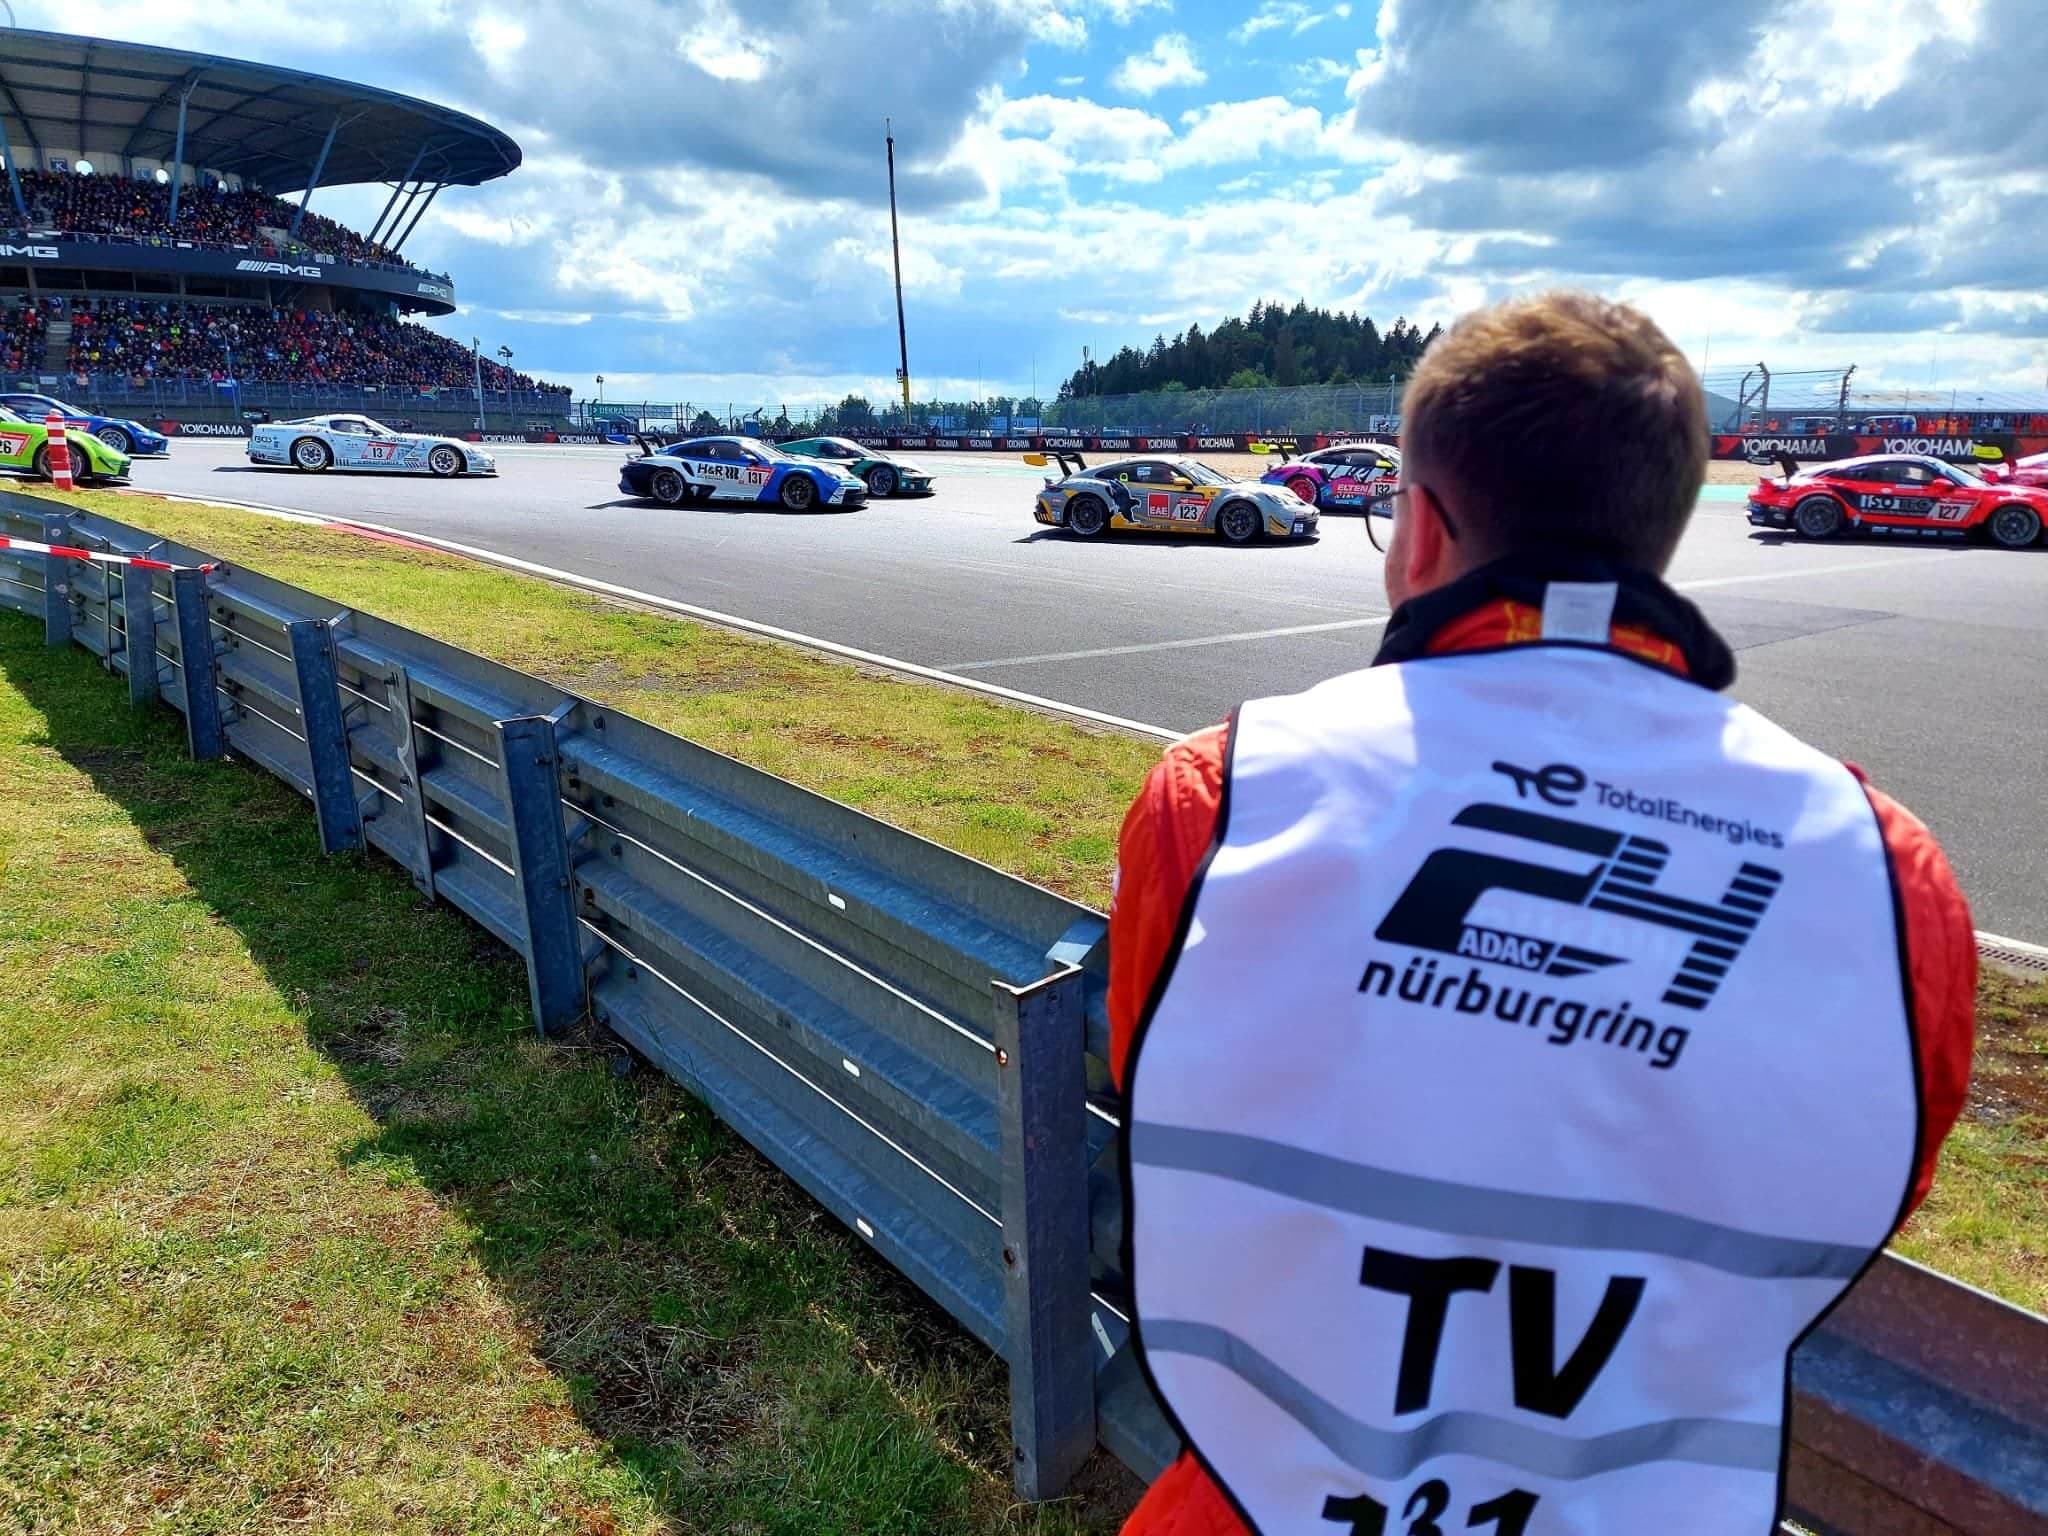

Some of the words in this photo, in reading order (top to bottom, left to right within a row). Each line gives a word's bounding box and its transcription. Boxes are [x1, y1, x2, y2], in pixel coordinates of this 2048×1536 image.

[0, 245, 59, 258] MG
[263, 262, 321, 278] AMG
[180, 423, 245, 435] YOKOHAMA
[480, 434, 526, 443] YOKOHAMA
[557, 435, 600, 444] YOKOHAMA
[1045, 438, 1083, 448] YOKOHAMA
[1100, 440, 1130, 448] YOKOHAMA
[1147, 440, 1177, 448] YOKOHAMA
[1197, 438, 1235, 448] YOKOHAMA
[372, 447, 383, 458] 13
[1742, 438, 1826, 455] YOKOHAMA
[698, 463, 723, 476] H&R
[748, 471, 762, 484] 131
[1337, 484, 1369, 492] ELTEN
[1375, 484, 1390, 496] 132
[1150, 506, 1168, 515] EAE
[1180, 506, 1197, 520] 123
[1938, 505, 1961, 520] 127
[1595, 780, 1785, 850] TotalEnergies
[1374, 803, 1784, 1010] 24
[1457, 927, 1543, 969] ADAC
[1357, 957, 1691, 1070] nürburgring
[1360, 1246, 1647, 1420] TV
